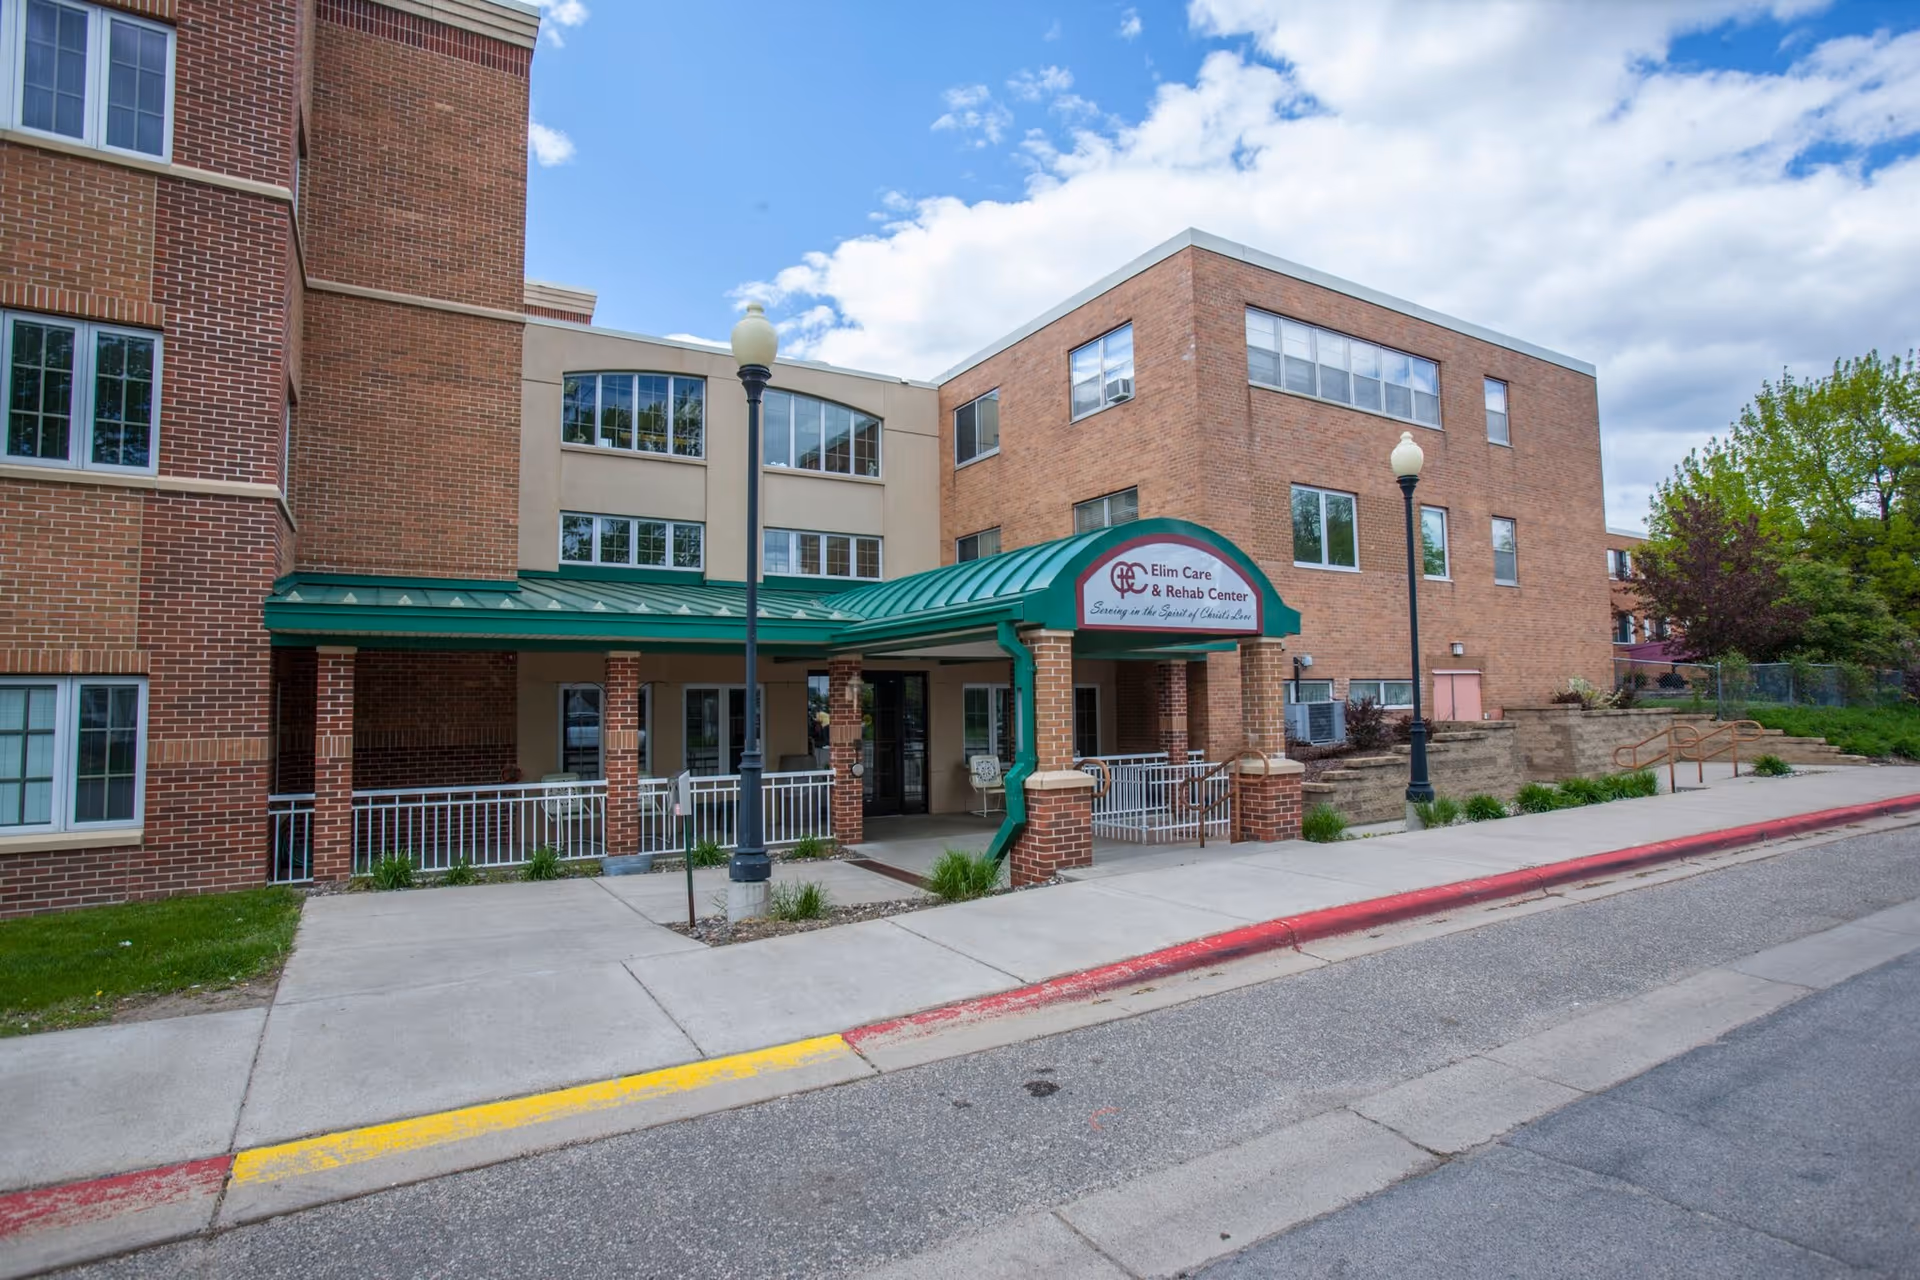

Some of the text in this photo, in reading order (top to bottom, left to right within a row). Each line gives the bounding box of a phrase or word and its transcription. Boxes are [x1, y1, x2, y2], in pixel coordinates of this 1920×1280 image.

[1151, 564, 1212, 581] Elim Care
[1151, 584, 1249, 602] & Rehab Center
[1090, 600, 1128, 620] Serving
[1129, 606, 1141, 616] in
[1142, 604, 1158, 617] the
[1158, 604, 1188, 620] Spirit
[1187, 607, 1201, 623] of
[1230, 607, 1252, 620] Love
